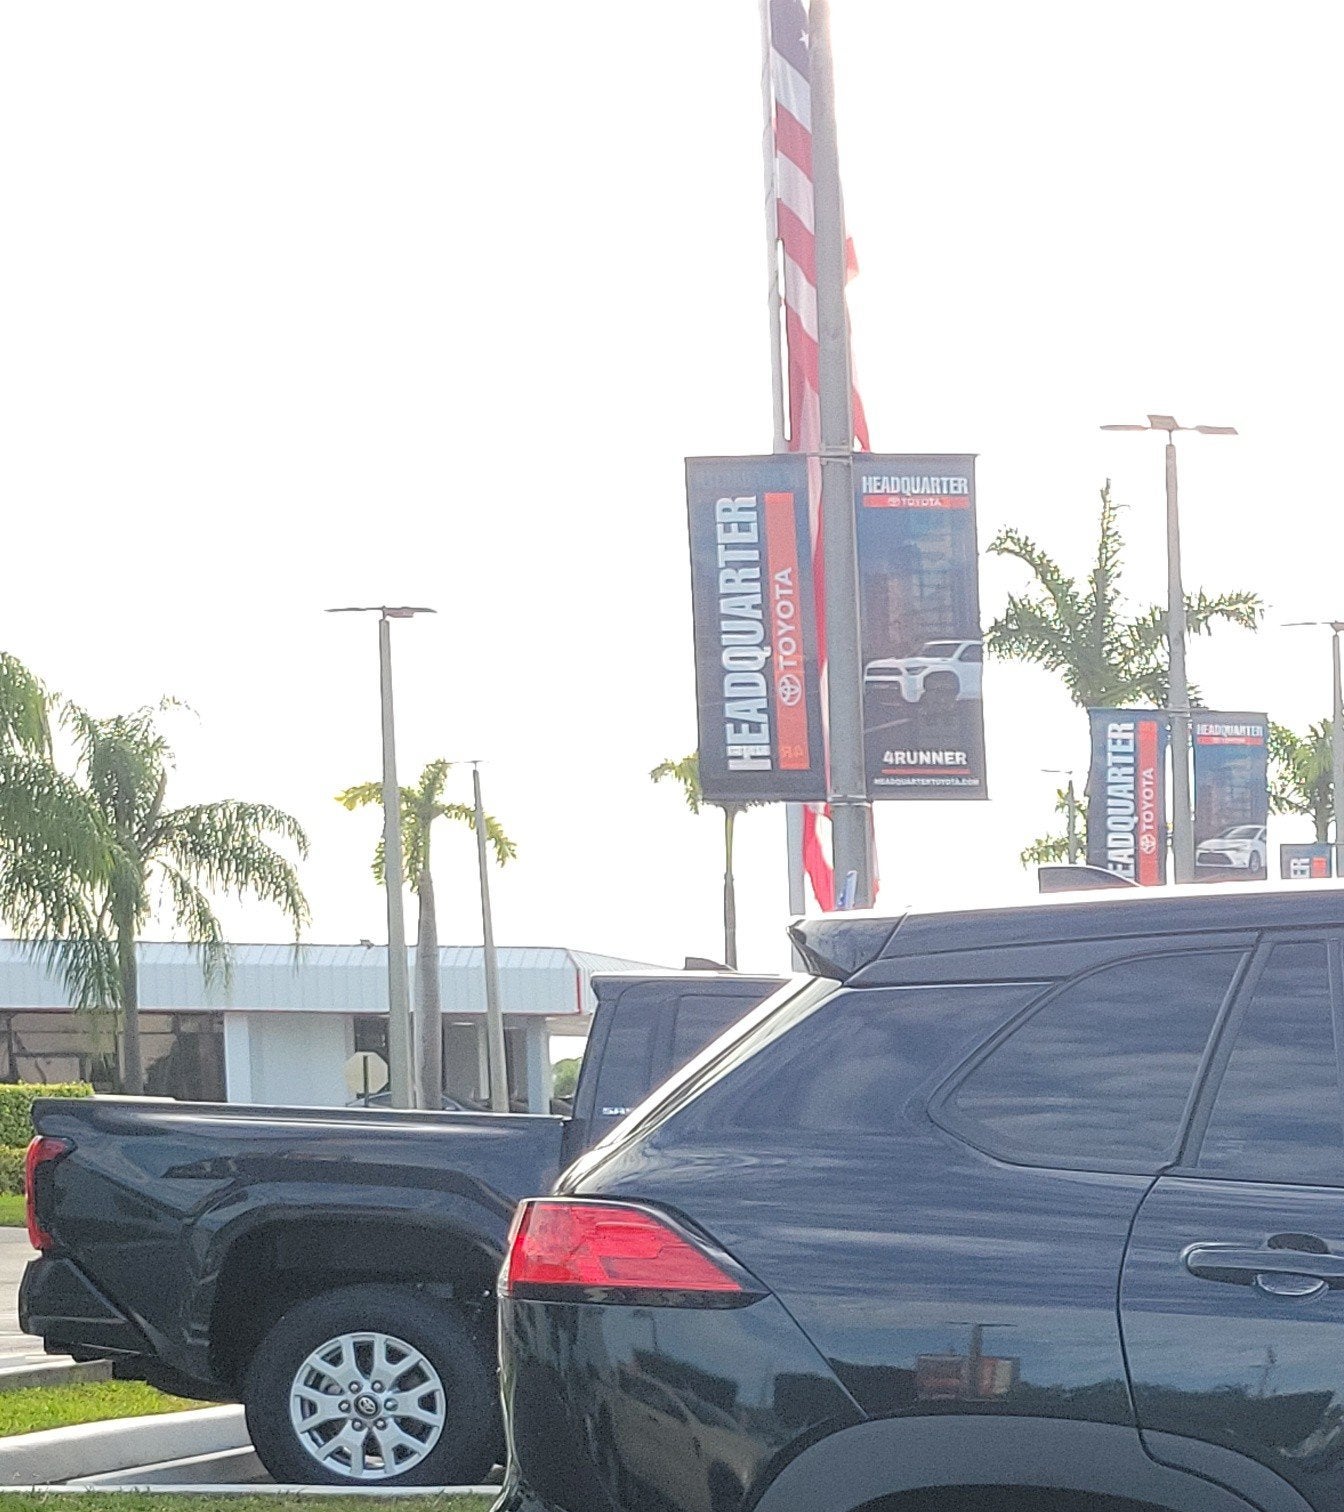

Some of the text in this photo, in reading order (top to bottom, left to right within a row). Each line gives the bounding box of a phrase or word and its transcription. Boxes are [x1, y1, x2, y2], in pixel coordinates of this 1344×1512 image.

[862, 476, 969, 496] HEADQUARTER
[902, 498, 942, 506] TOYOTA
[716, 495, 772, 771] HEADQUARTER
[775, 567, 797, 670] TOYOTA
[883, 750, 967, 765] 4RUNNER
[1107, 722, 1138, 881] EADQUARTER
[1142, 767, 1154, 831] TOYOTA
